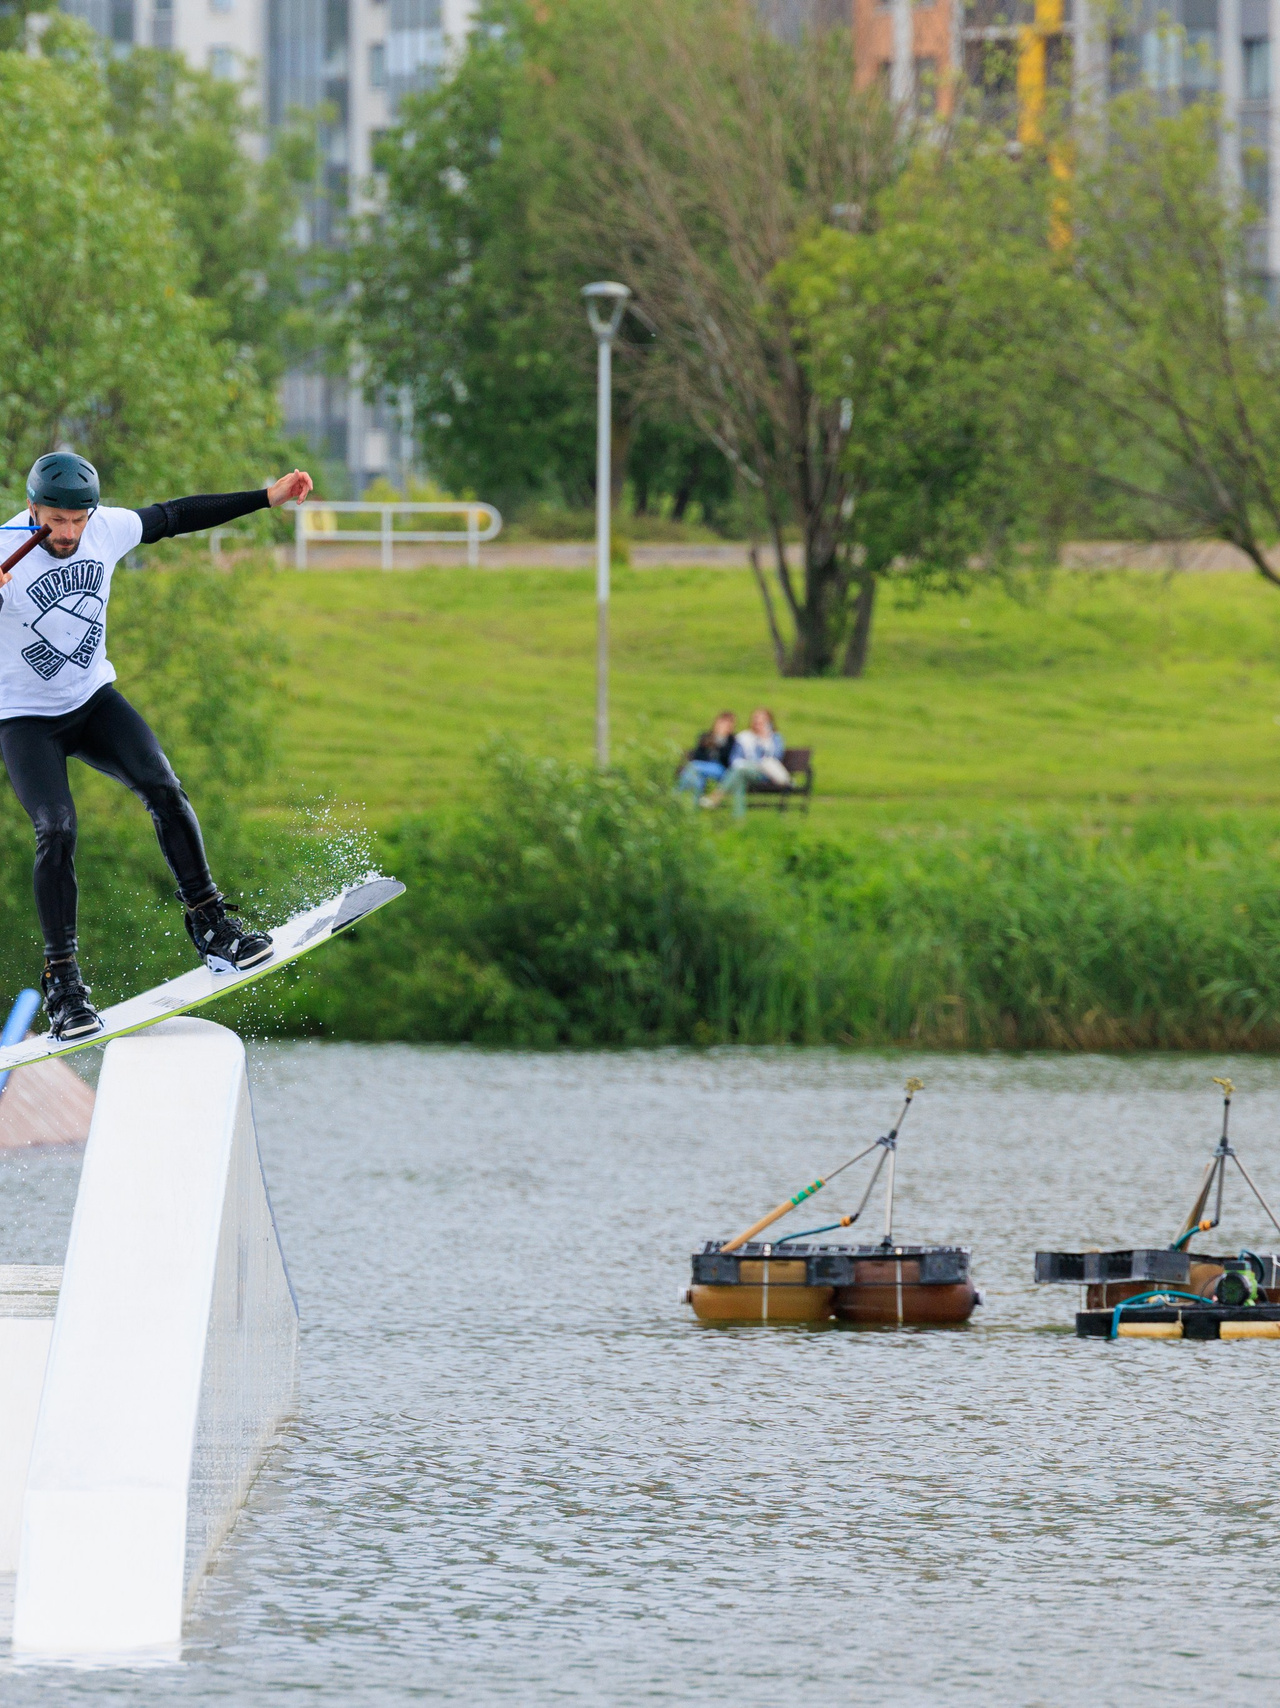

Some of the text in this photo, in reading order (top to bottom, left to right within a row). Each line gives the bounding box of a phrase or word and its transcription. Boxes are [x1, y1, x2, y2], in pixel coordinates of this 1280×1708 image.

[30, 563, 103, 609] KUPCHINO
[24, 644, 66, 679] OPEN
[73, 626, 103, 665] 2025
